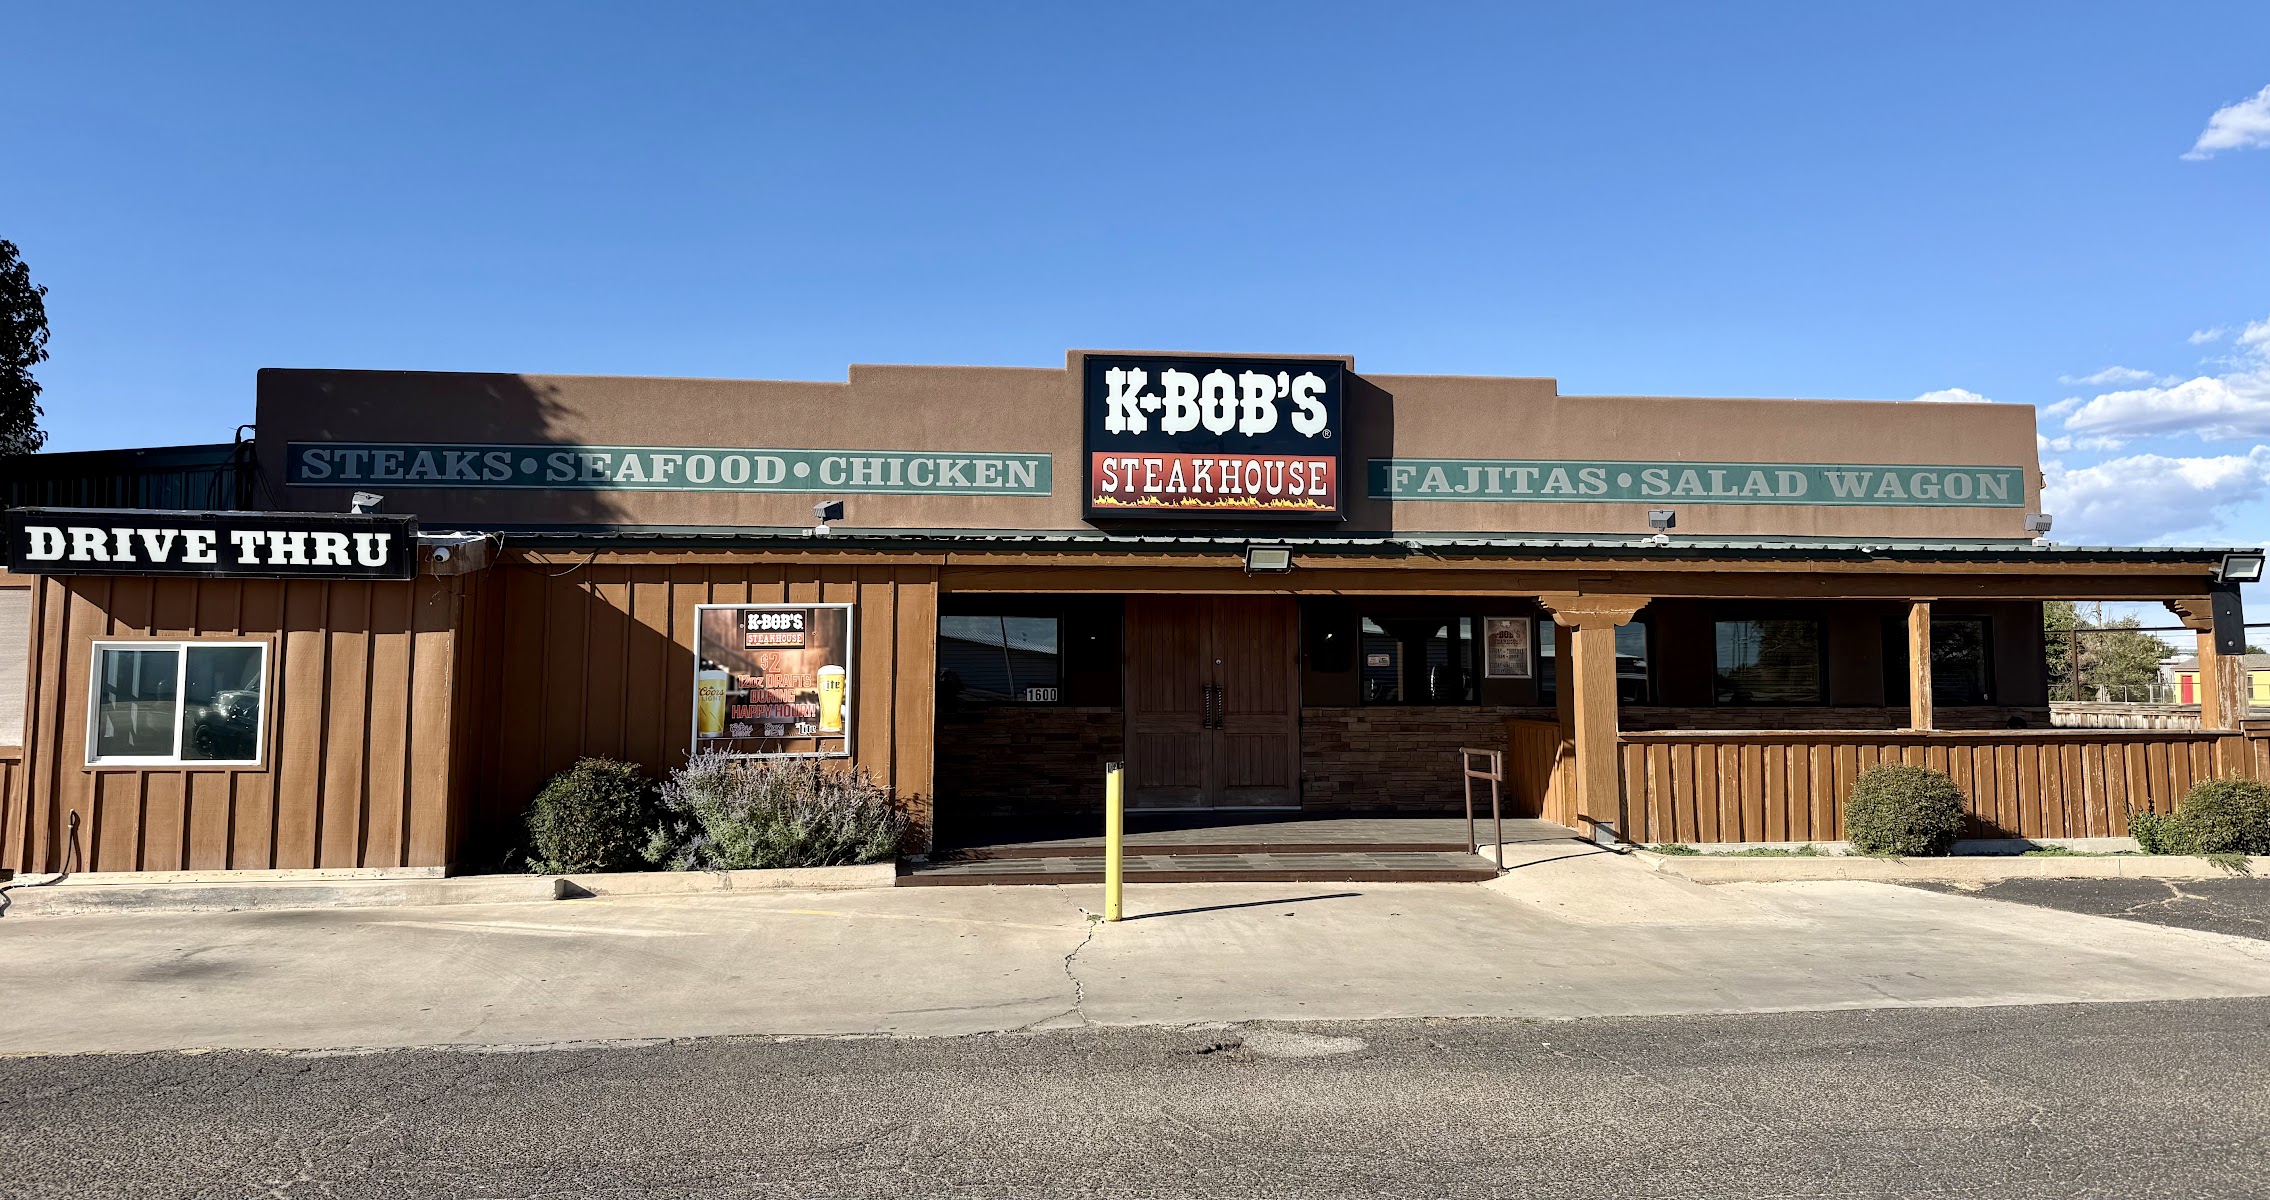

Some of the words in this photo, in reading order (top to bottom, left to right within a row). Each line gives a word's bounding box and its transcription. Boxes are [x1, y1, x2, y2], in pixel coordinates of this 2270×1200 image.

[1105, 366, 1328, 438] K-BOB'S
[301, 448, 513, 482] STEAKS
[546, 451, 787, 485] SEAFOOD
[819, 456, 1039, 488] CHICKEN
[1101, 457, 1328, 496] STEAKHOUSE
[1382, 465, 1608, 495] FAJITAS
[1641, 468, 1808, 498] SALAD
[1824, 471, 2010, 500] WAGON
[24, 526, 218, 564] DRIVE
[231, 530, 391, 567] THRU
[747, 613, 803, 630] K-BOB'S
[748, 634, 803, 643] STEAKHOUSE
[760, 651, 781, 673] $2
[765, 673, 812, 688] DRAFTS
[699, 686, 724, 696] Coors
[750, 688, 796, 703] DURING
[1028, 688, 1056, 700] 1600
[731, 704, 774, 719] HAPPY
